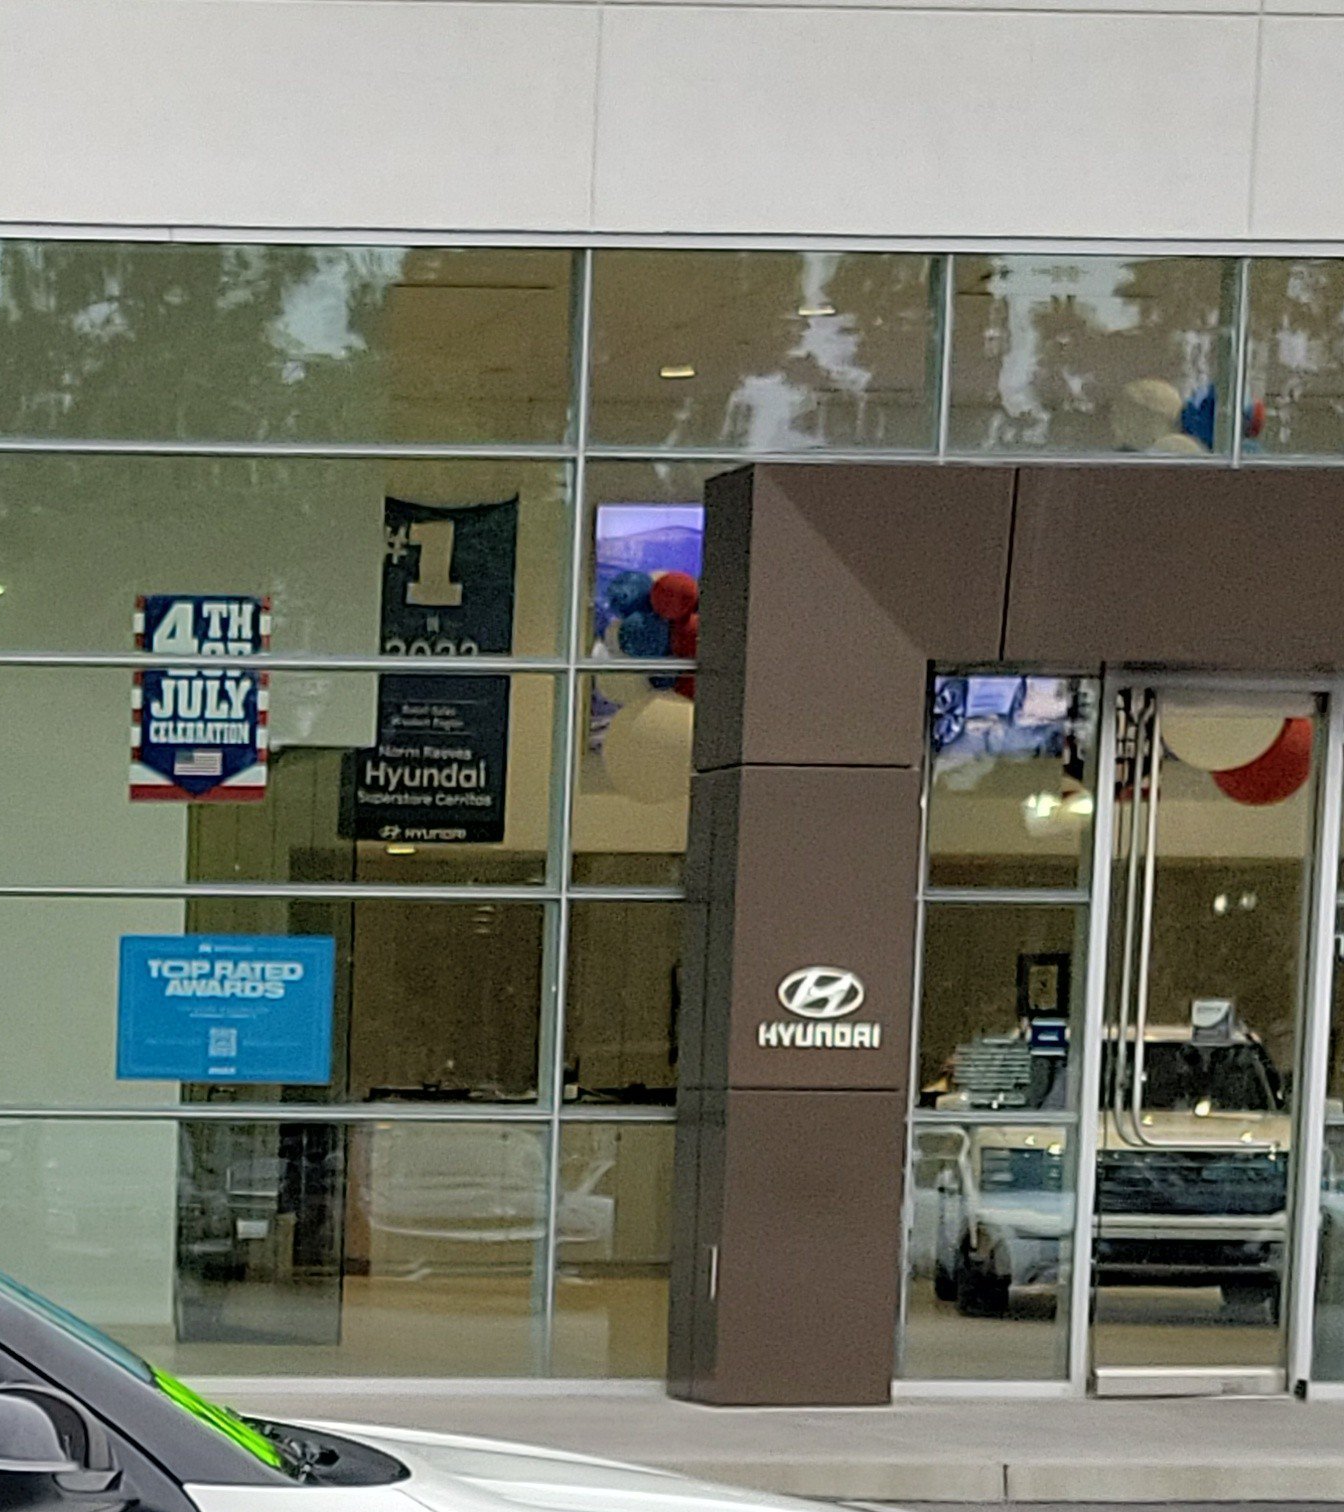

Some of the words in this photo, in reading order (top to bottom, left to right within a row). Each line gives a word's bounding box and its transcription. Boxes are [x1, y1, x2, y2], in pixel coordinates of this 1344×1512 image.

[385, 520, 462, 606] #1
[153, 603, 254, 676] 4TH
[150, 679, 252, 719] JULY
[149, 720, 250, 744] CELEBRATION
[365, 759, 487, 791] Hyundai
[357, 790, 433, 806] Superstore
[435, 793, 493, 807] Cerritos
[405, 828, 467, 840] HYUNDAI
[148, 959, 210, 979] TOP
[214, 960, 304, 981] RATED
[165, 979, 286, 999] AWARDS
[758, 1021, 881, 1048] HYUNDAI
